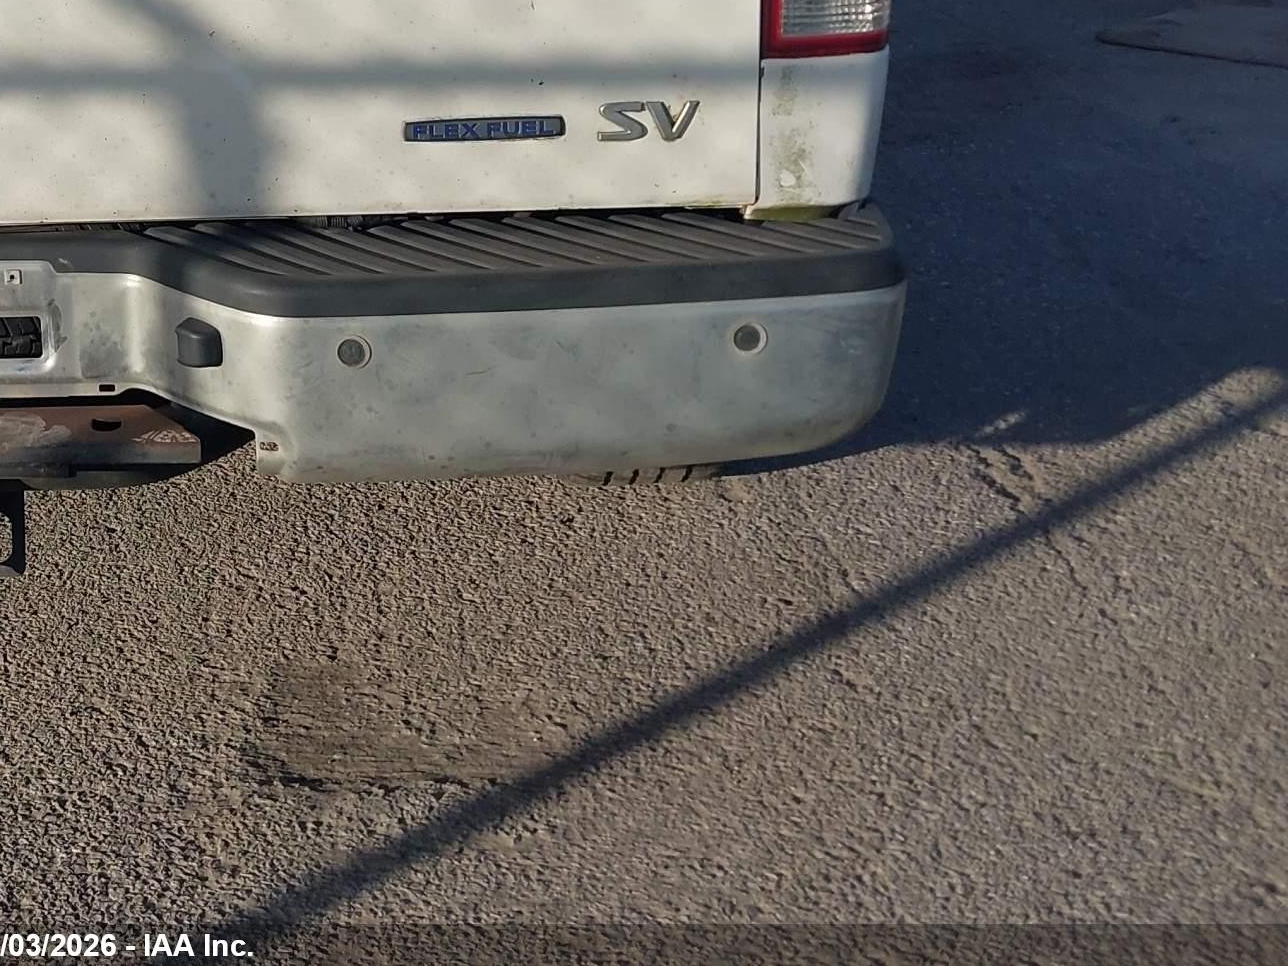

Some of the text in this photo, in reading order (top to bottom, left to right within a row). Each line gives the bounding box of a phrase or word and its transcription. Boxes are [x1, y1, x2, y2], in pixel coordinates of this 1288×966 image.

[412, 120, 557, 139] FLEX FUEL
[596, 100, 701, 142] SV
